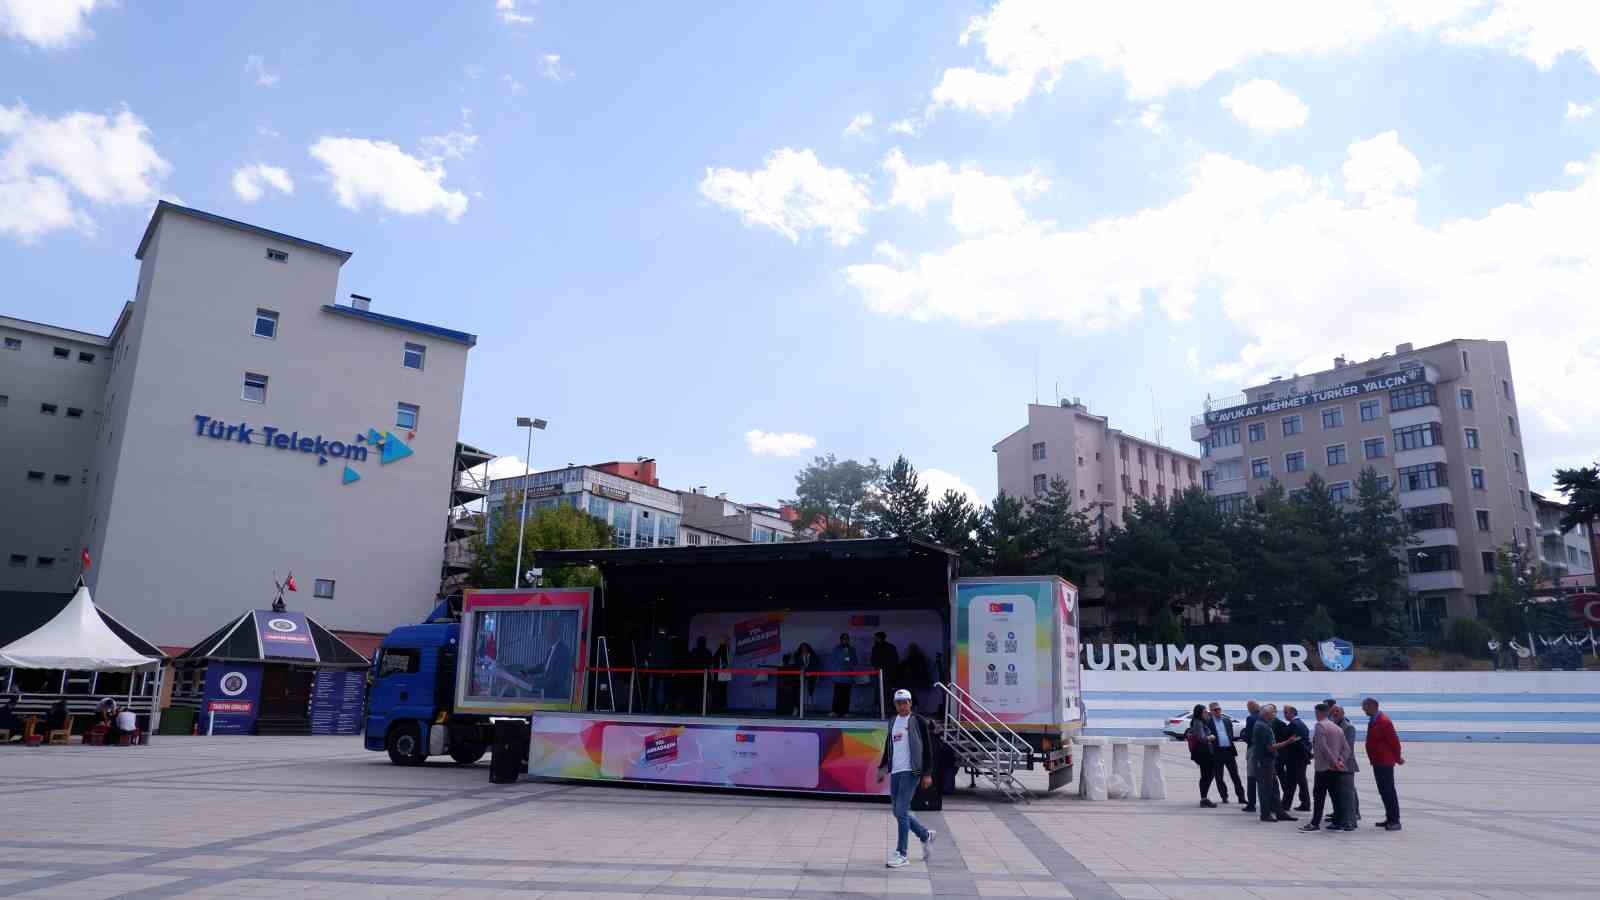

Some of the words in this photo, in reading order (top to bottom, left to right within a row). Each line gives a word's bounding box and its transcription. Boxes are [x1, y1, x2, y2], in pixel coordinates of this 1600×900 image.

[1218, 407, 1258, 422] AVUKAT
[1262, 396, 1308, 413] MEHMET
[1362, 375, 1407, 392] YALÇIN
[195, 415, 253, 444] Türk
[263, 425, 368, 463] Telekom
[1080, 643, 1311, 672] URUMSPOR
